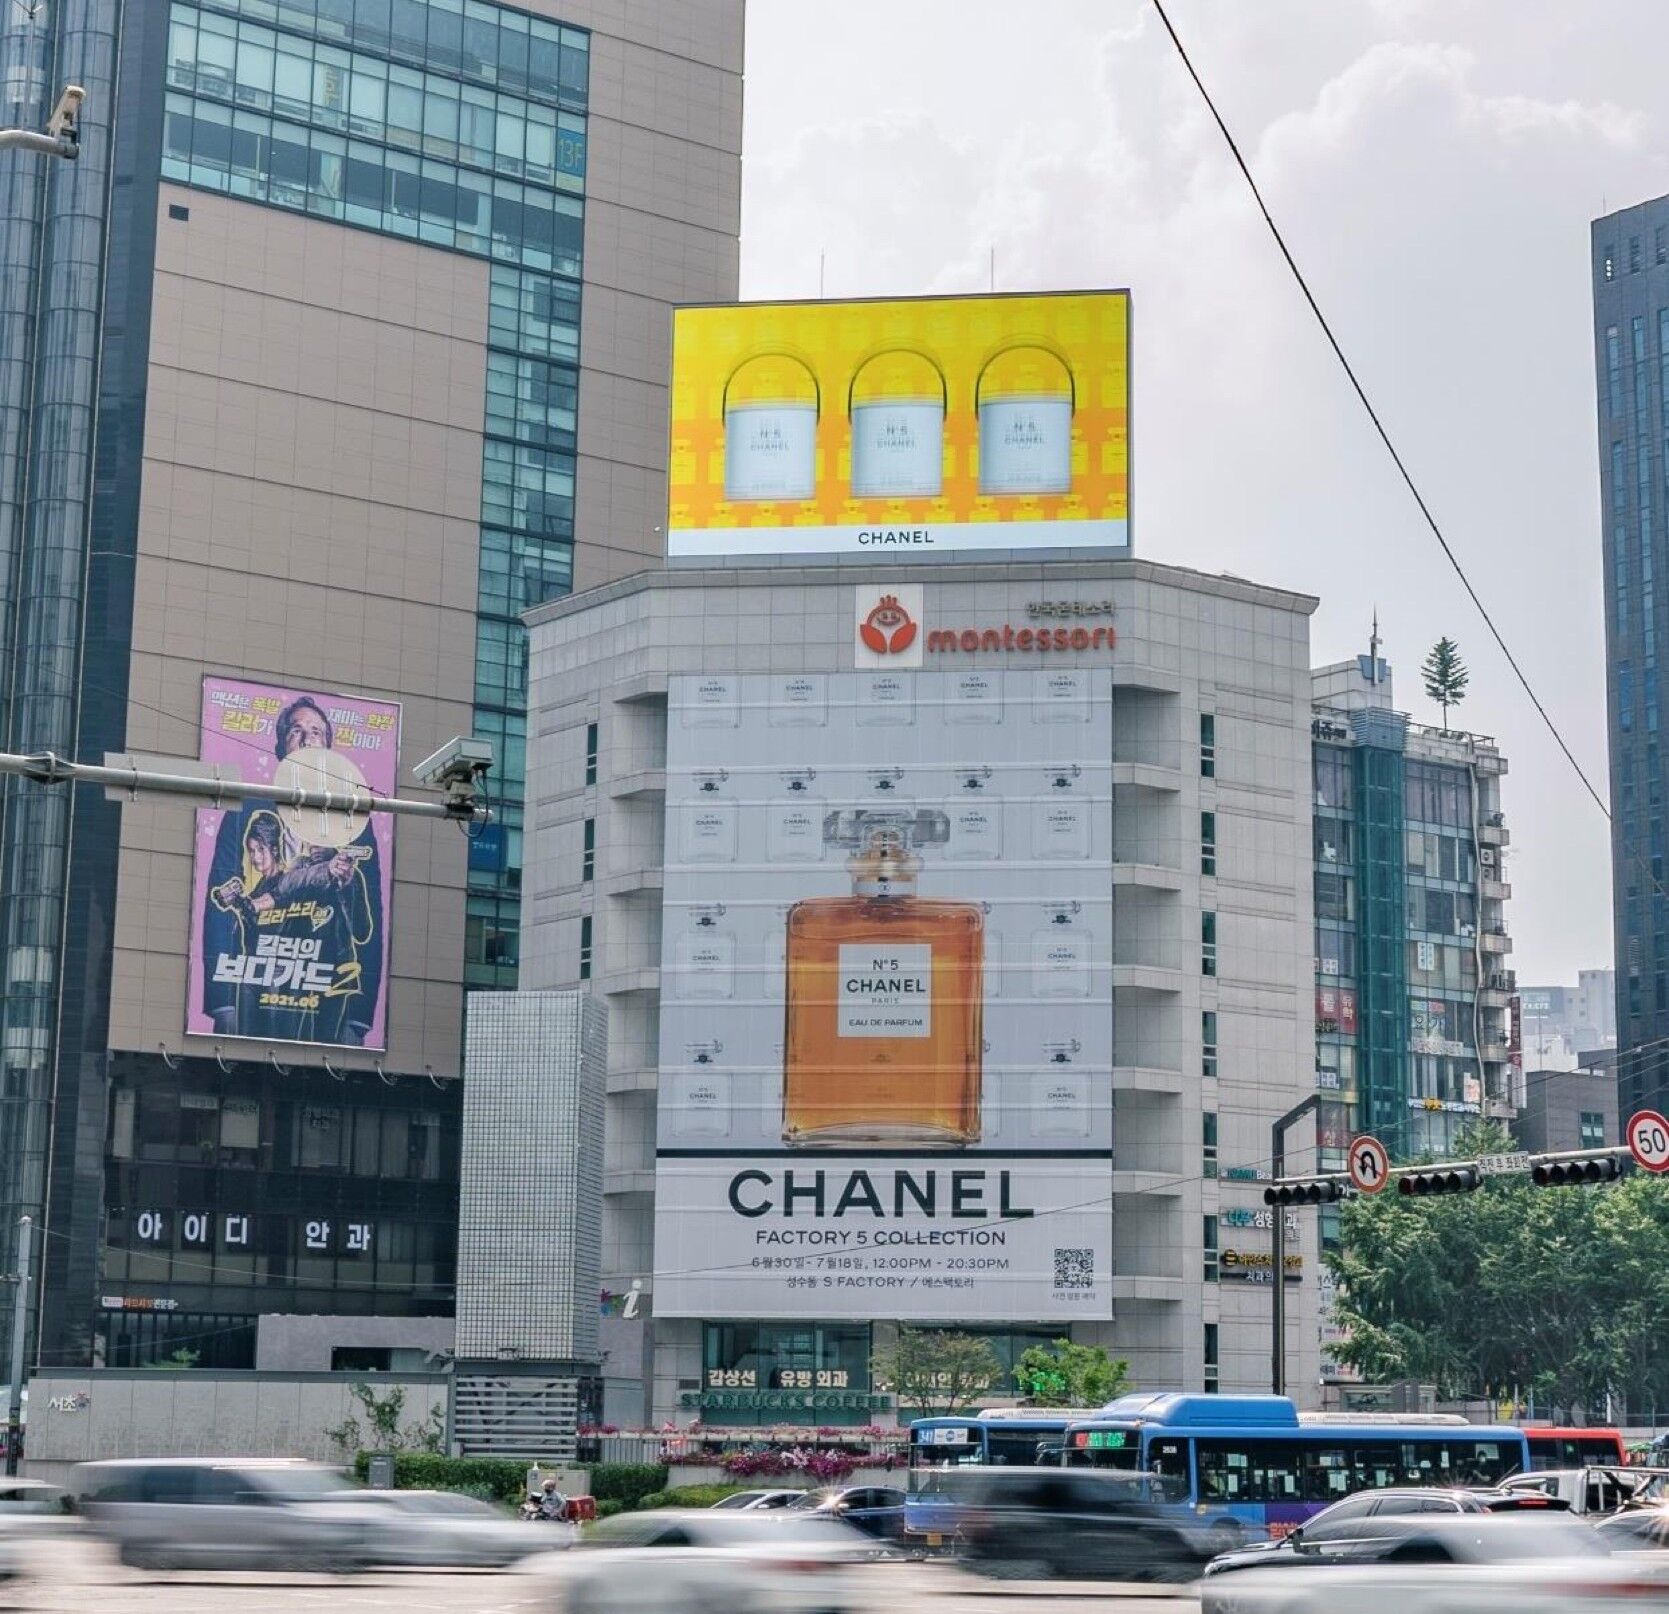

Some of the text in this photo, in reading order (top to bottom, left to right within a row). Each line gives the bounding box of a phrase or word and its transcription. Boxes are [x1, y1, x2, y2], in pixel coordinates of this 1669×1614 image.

[858, 530, 935, 545] CHANEL
[927, 624, 1116, 653] montessori
[256, 934, 322, 961] 킬러의
[846, 978, 927, 993] CHANEL
[259, 993, 320, 1008] 2021.06
[884, 1018, 923, 1026] PARFUM
[1637, 1127, 1666, 1154] 50
[728, 1169, 1034, 1218] CHANEL
[137, 1212, 371, 1251] 아이디 안과
[756, 1230, 1006, 1246] FACTORY 5 COLLECTION
[873, 1257, 931, 1269] 12:00PM
[946, 1257, 1010, 1269] 20:30PM
[823, 1276, 833, 1288] S
[837, 1276, 905, 1288] FACTORY
[910, 1276, 917, 1288] /
[780, 1370, 812, 1388] 유방
[816, 1370, 849, 1388] 외과
[680, 1393, 891, 1410] STARBUCKS COFFEE
